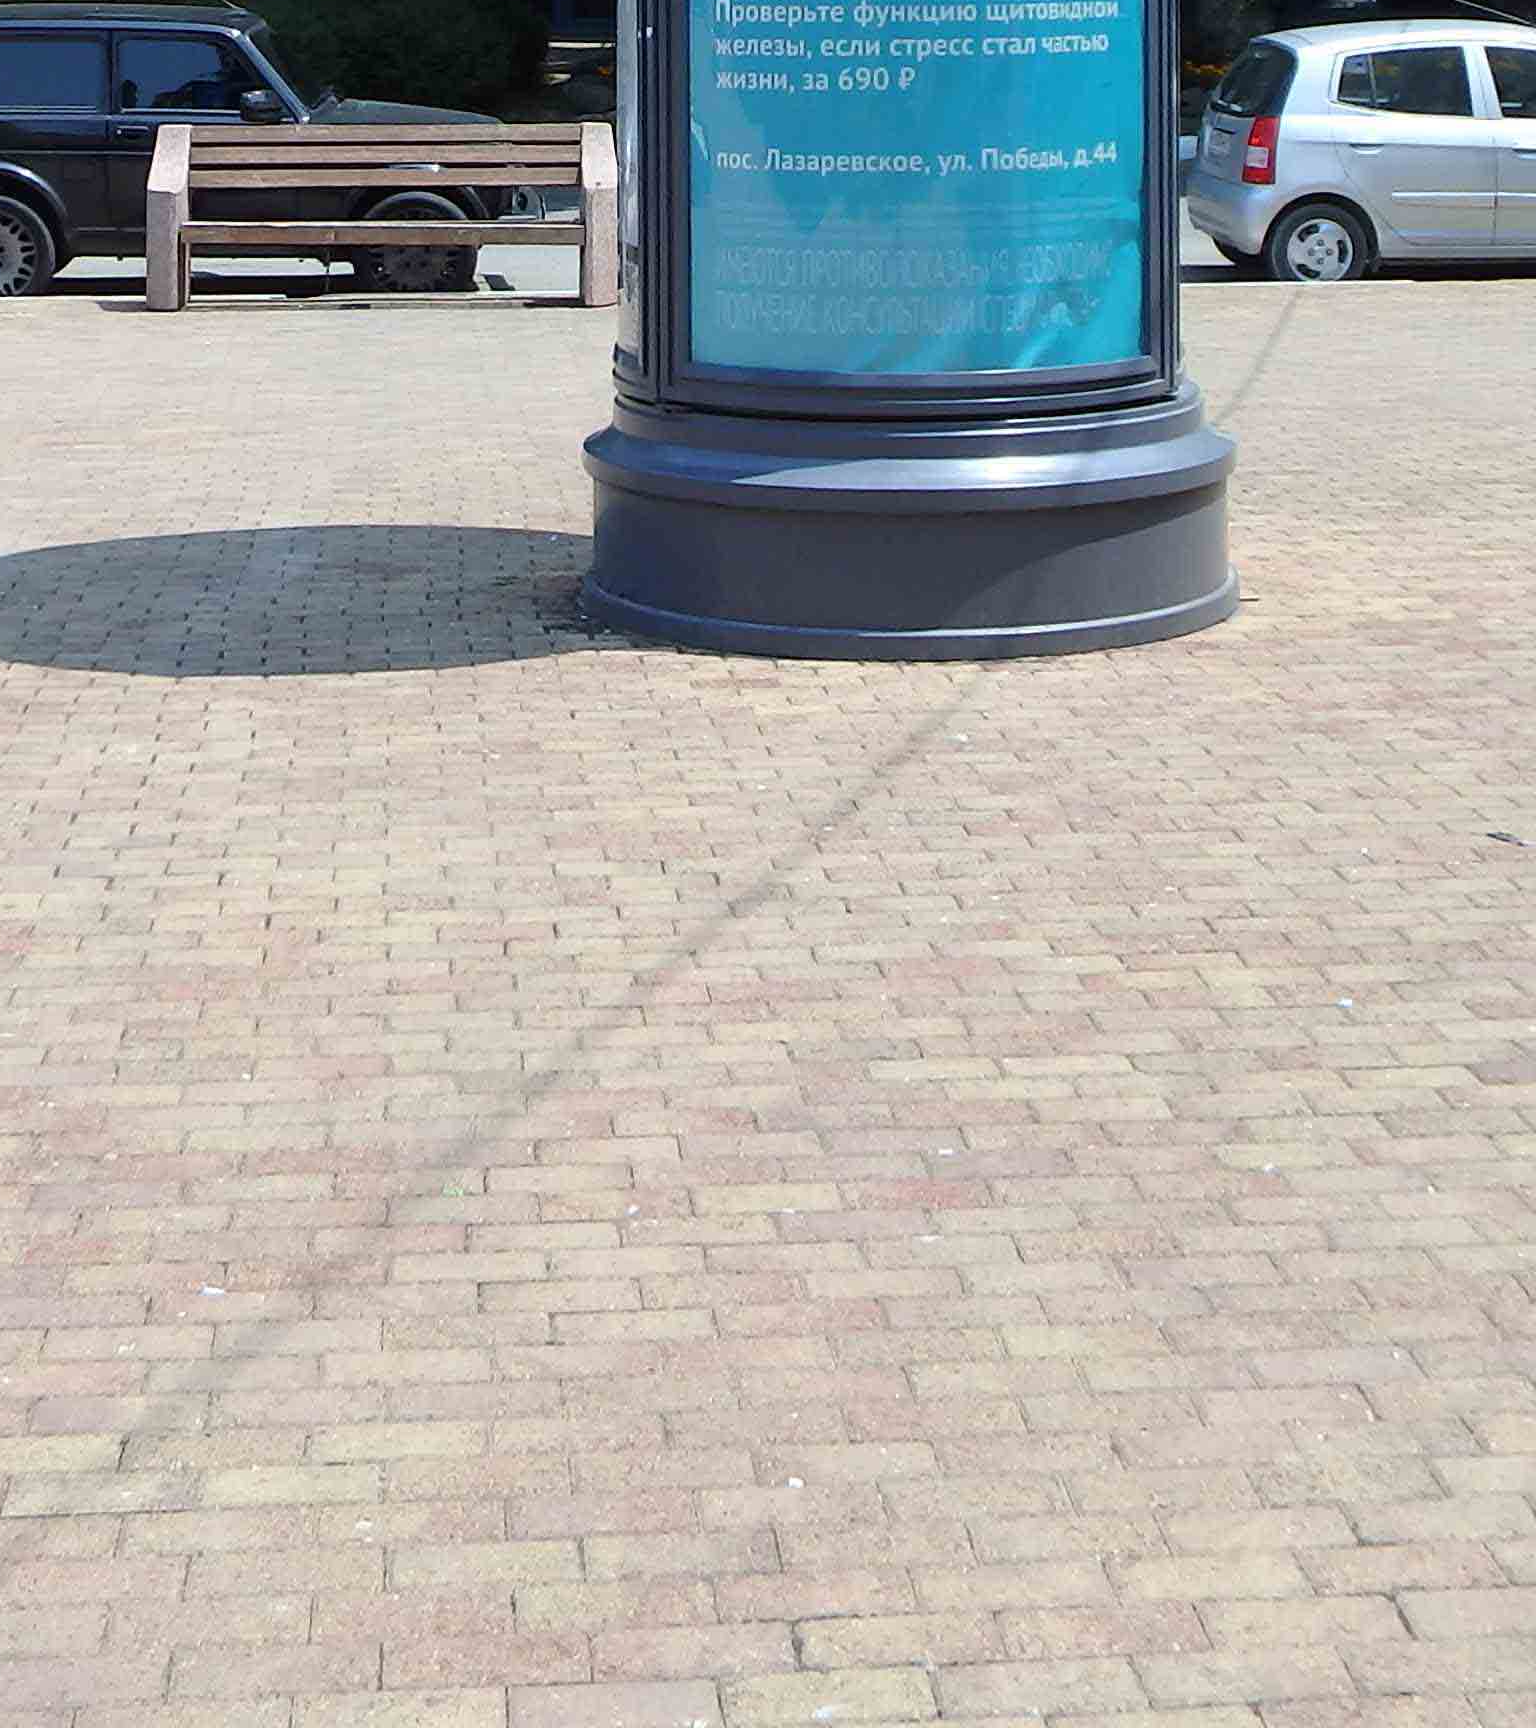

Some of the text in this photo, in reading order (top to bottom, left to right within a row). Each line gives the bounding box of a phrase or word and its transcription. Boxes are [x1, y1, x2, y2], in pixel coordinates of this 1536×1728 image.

[715, 0, 845, 28] Проверьте
[853, 0, 977, 28] функцию
[715, 33, 1110, 61] железы, если стресс стал частью
[716, 66, 916, 93] жизни, за 690 ₽
[716, 140, 1118, 176] пос. Лазаревское, ул. Победы, д.44
